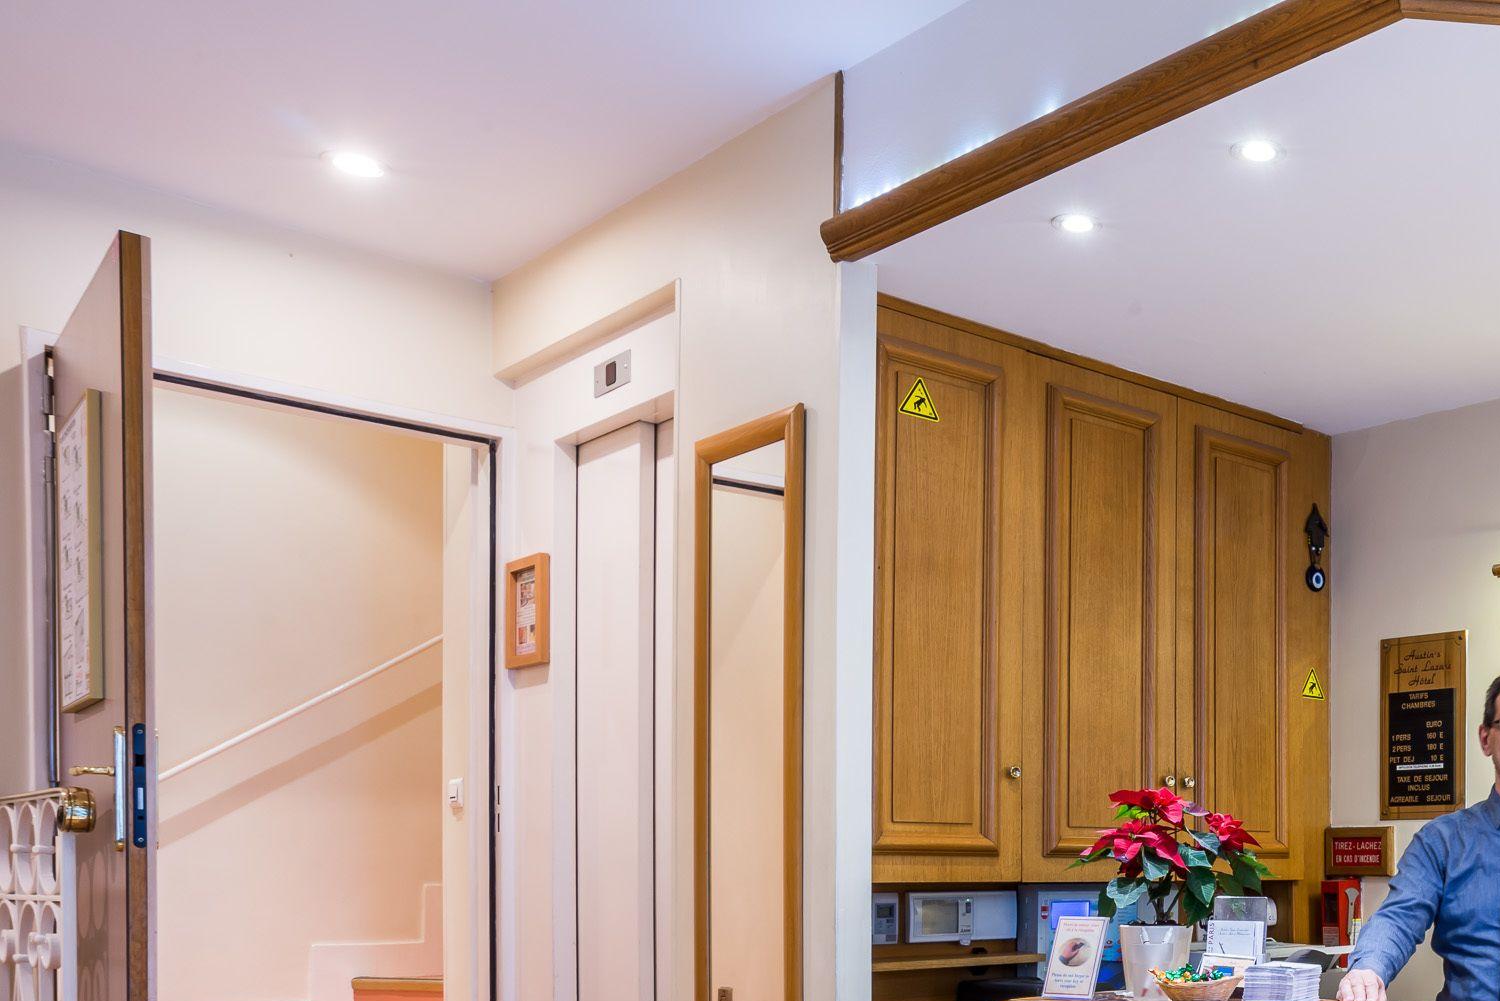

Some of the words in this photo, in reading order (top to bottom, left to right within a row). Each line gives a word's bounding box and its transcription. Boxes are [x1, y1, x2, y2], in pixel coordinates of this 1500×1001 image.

[1404, 649, 1441, 661] Austin's
[1394, 662, 1418, 675] Saint
[1421, 660, 1452, 672] Lazare
[1409, 692, 1429, 700] TARIFS
[1401, 700, 1436, 710] CHAMBRES
[1426, 720, 1443, 728] EURO
[1389, 756, 1400, 764] PET
[1397, 775, 1411, 783] TAXE
[1424, 774, 1448, 782] SEJOUR
[1426, 794, 1451, 802] SEJOUR
[1343, 854, 1353, 863] CAS
